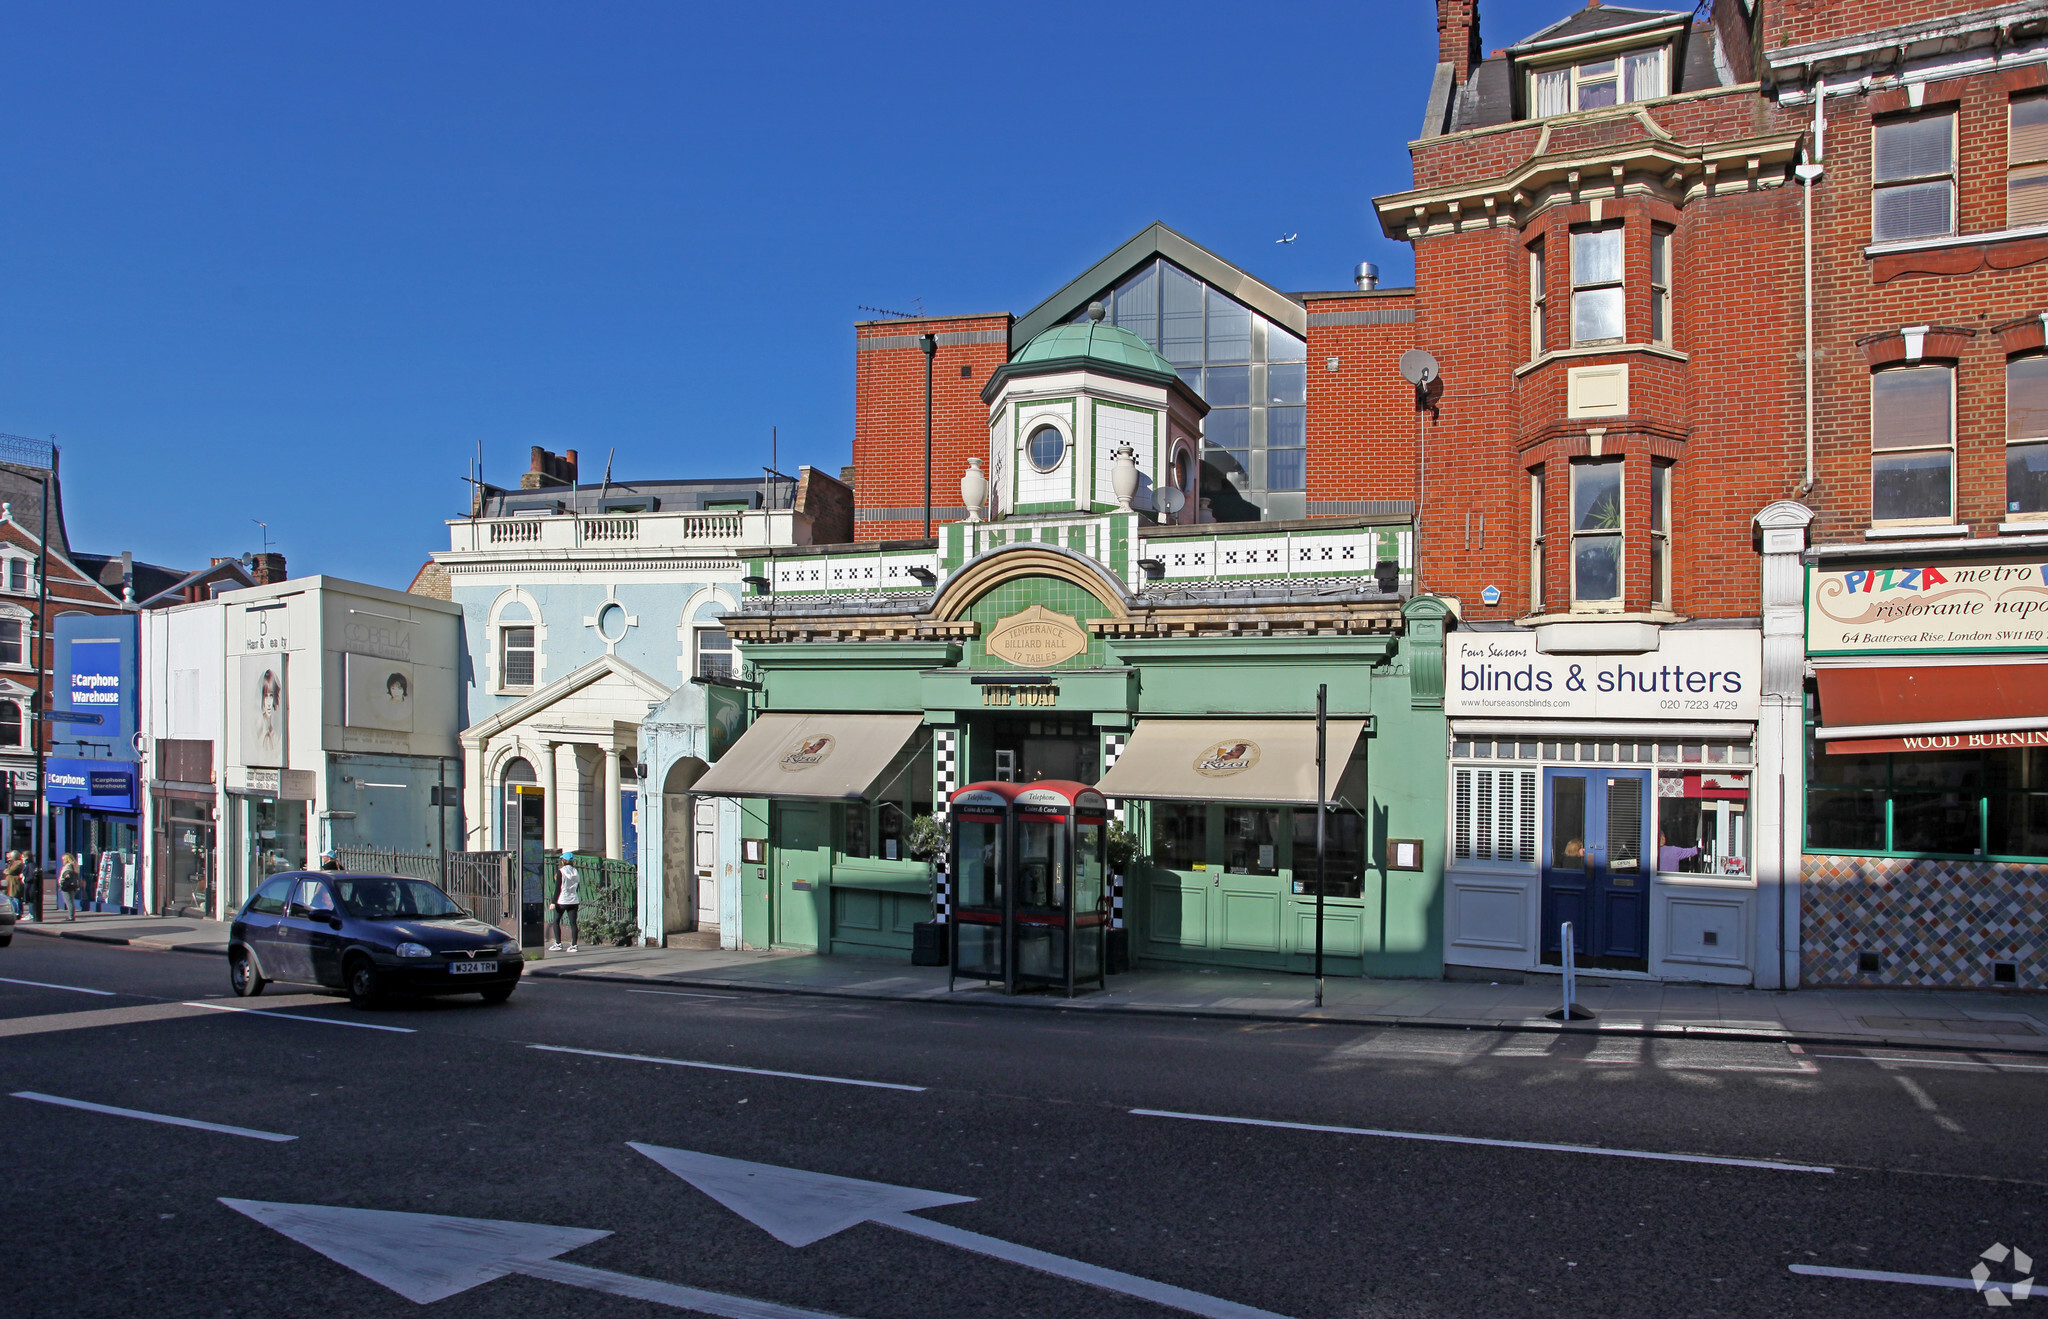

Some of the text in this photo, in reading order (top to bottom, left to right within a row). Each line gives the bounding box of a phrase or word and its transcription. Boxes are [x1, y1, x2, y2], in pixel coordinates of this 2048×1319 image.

[1844, 566, 1949, 594] PIZZA
[1953, 566, 2032, 583] metro
[1876, 600, 1984, 618] ristorante
[260, 610, 267, 636] B
[1009, 624, 1065, 639] TEMPERANCE
[1842, 632, 1860, 644] 64
[1862, 633, 1917, 644] Battersea
[1947, 631, 1993, 642] London
[1995, 631, 2023, 641] SW11
[1005, 640, 1067, 648] BILLIARD HALL
[1461, 643, 1527, 658] Four Seasons
[1013, 651, 1057, 662] 17 TABLES
[76, 673, 119, 689] Carphone
[1461, 664, 1742, 693] blinds & shutters
[72, 690, 119, 703] Warehouse
[983, 684, 1011, 706] THE
[1461, 699, 1571, 708] www.fourseasonsblinds.com
[1660, 700, 1738, 710] 020 7223 4729
[1903, 736, 1960, 749] WOOD
[1198, 760, 1249, 770] Kozel
[51, 774, 85, 786] Carphone
[967, 794, 992, 802] Telephone
[1029, 793, 1055, 802] Telephone
[456, 963, 496, 972] W324 TRW
